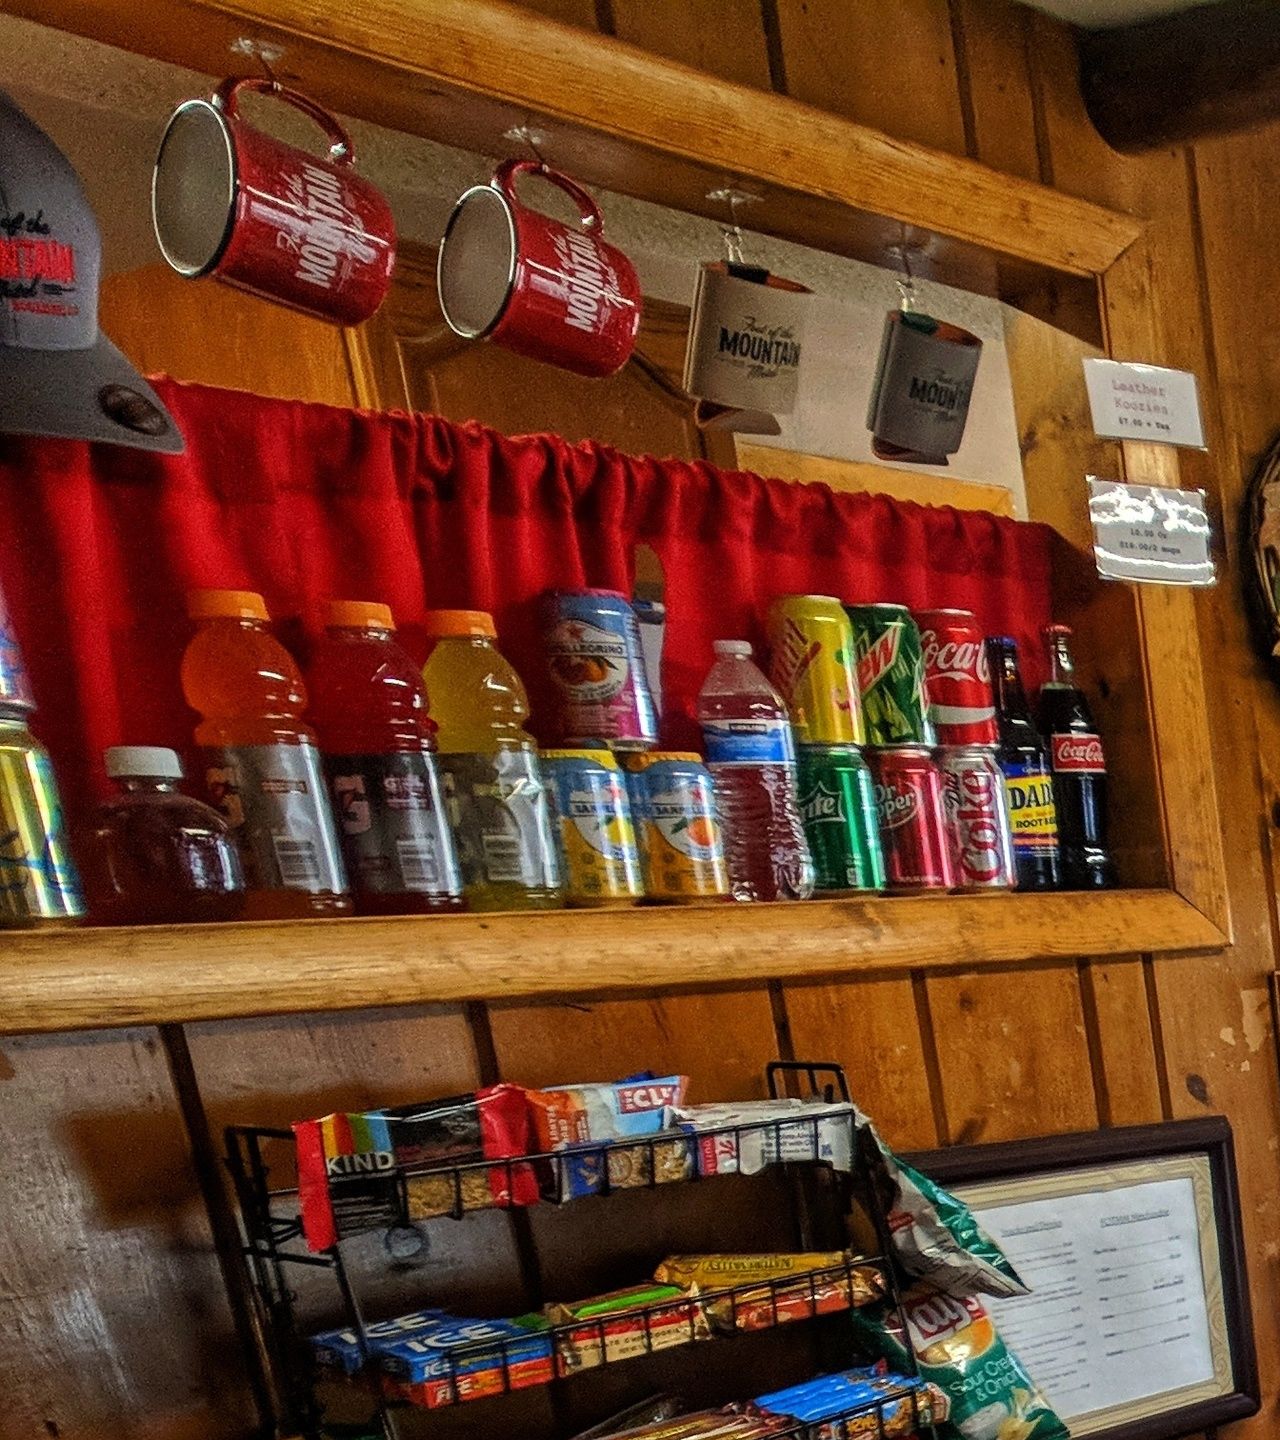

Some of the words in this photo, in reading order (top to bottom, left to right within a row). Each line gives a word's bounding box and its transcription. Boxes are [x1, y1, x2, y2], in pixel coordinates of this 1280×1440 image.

[1112, 379, 1167, 397] Leather
[325, 1151, 394, 1177] KIND
[405, 1322, 504, 1352] ICE
[949, 1367, 986, 1397] Sour
[984, 1354, 1013, 1377] Crea
[977, 1388, 987, 1402] &
